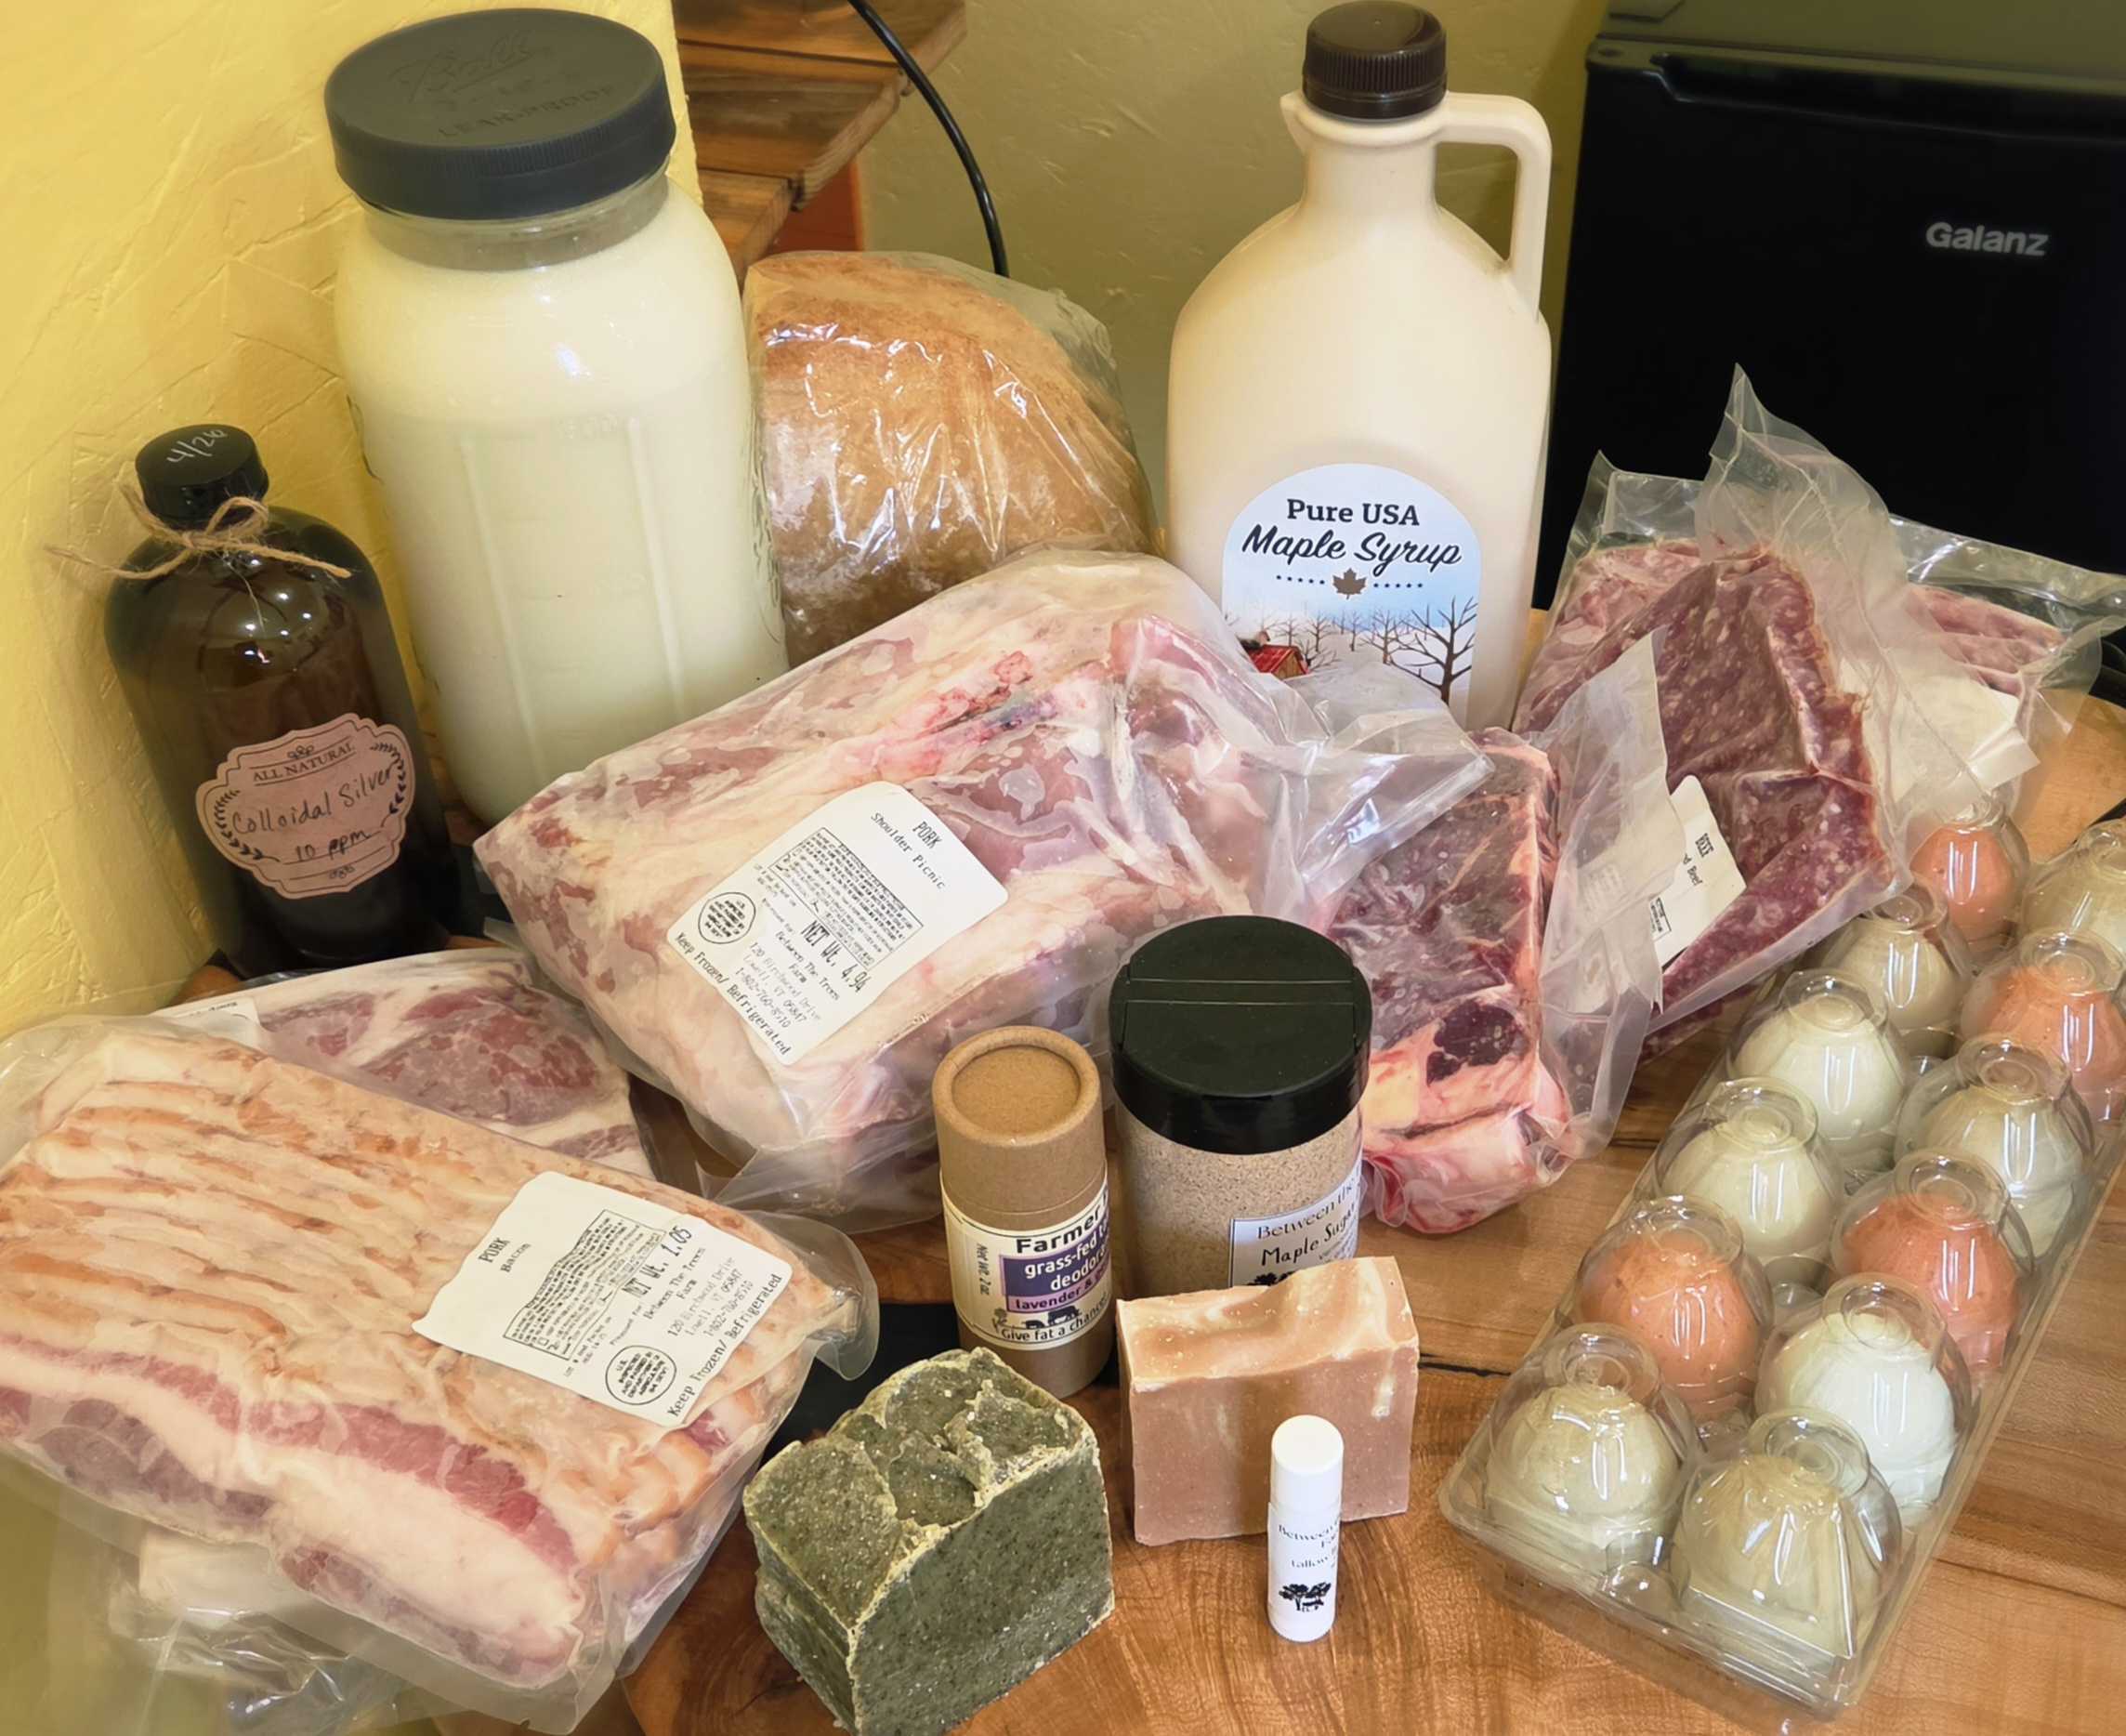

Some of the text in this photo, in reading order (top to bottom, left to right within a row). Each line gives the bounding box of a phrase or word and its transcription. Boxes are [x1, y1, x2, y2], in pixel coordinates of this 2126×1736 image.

[1926, 222, 2048, 256] Galanz
[1287, 499, 1419, 526] Pure USA
[1241, 524, 1462, 577] Maple Syrup
[253, 743, 355, 783] ALL NATURAL
[232, 762, 398, 834] Colloidal Silver
[871, 812, 946, 888] Shoulder Picnic
[912, 820, 942, 849] PORK
[295, 844, 316, 861] 10
[800, 919, 829, 948] NET
[839, 961, 872, 993] 4.94
[674, 932, 697, 954] Keep
[725, 983, 792, 1056] Refrigerated
[1017, 1205, 1099, 1254] Farmer
[1258, 1202, 1334, 1239] Between
[478, 1235, 510, 1263] PORK
[659, 1223, 693, 1256] 1.05
[1025, 1235, 1098, 1279] grass-fed
[1261, 1237, 1319, 1266] Maple
[499, 1243, 532, 1273] Bacon
[1016, 1287, 1080, 1309] lavender
[666, 1384, 697, 1417] Keep
[725, 1271, 783, 1338] Refrigerated
[1002, 1330, 1030, 1342] Give
[1035, 1326, 1053, 1341] fat
[1058, 1326, 1066, 1336] a
